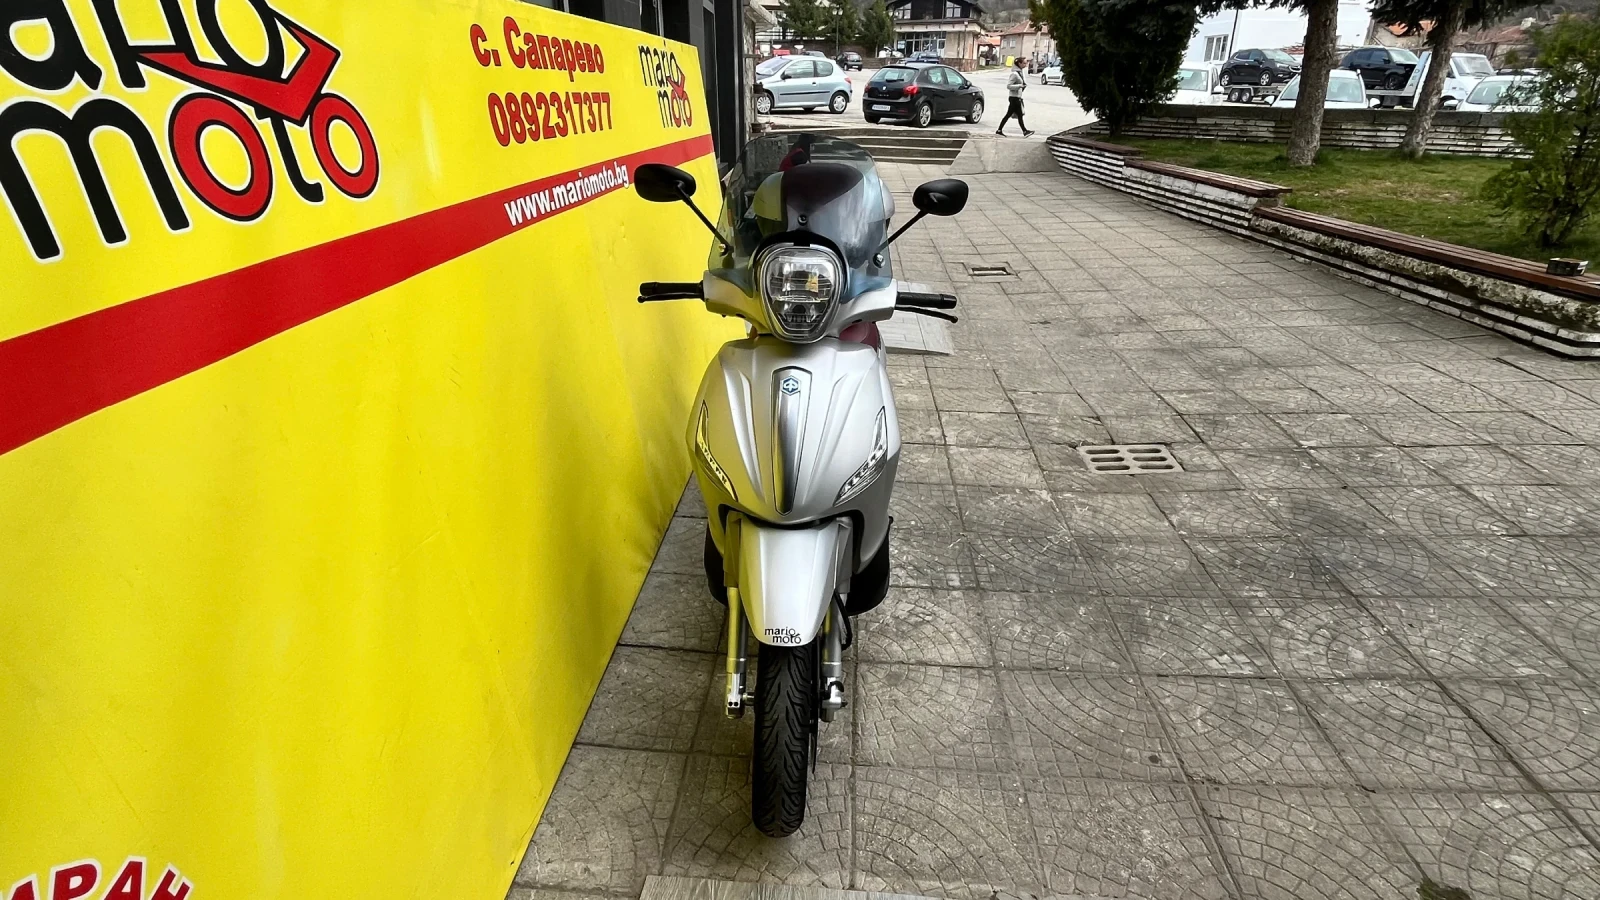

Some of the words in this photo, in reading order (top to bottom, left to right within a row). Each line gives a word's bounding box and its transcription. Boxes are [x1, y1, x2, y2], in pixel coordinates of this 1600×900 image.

[469, 23, 502, 67] с.
[503, 16, 605, 82] Сапарево
[638, 40, 680, 88] mario
[487, 91, 613, 147] 0892317377
[657, 89, 693, 129] moto
[503, 160, 630, 227] www.mariomoto.bg
[764, 626, 796, 636] mario
[772, 635, 802, 645] moto
